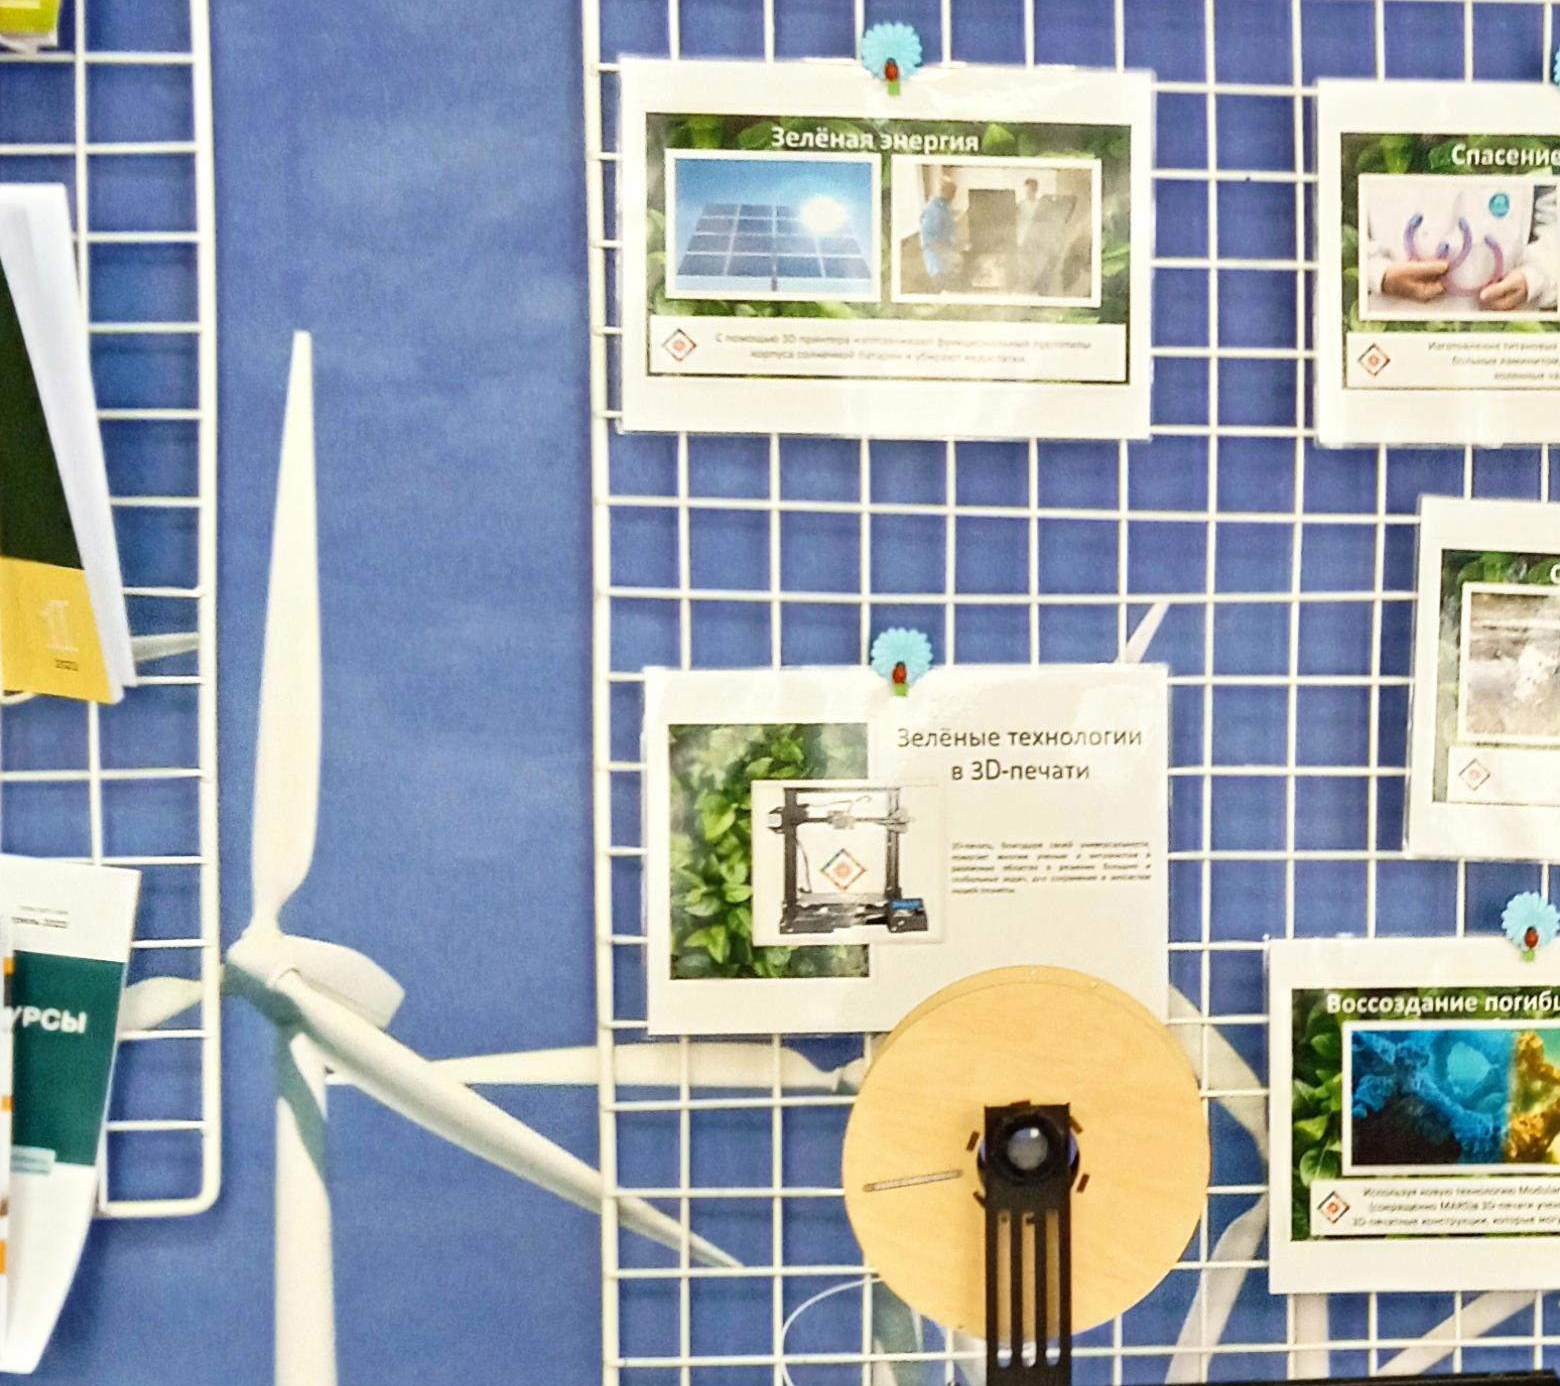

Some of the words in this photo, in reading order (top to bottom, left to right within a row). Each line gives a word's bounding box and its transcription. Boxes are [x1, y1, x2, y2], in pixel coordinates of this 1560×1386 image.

[770, 125, 875, 150] Зелёная
[879, 133, 980, 156] энергия
[896, 727, 1001, 748] Зелёные
[1006, 729, 1142, 747] технологии
[951, 765, 964, 781] в
[970, 758, 1090, 781] 3D-печати
[1325, 991, 1478, 1016] Воссоздание
